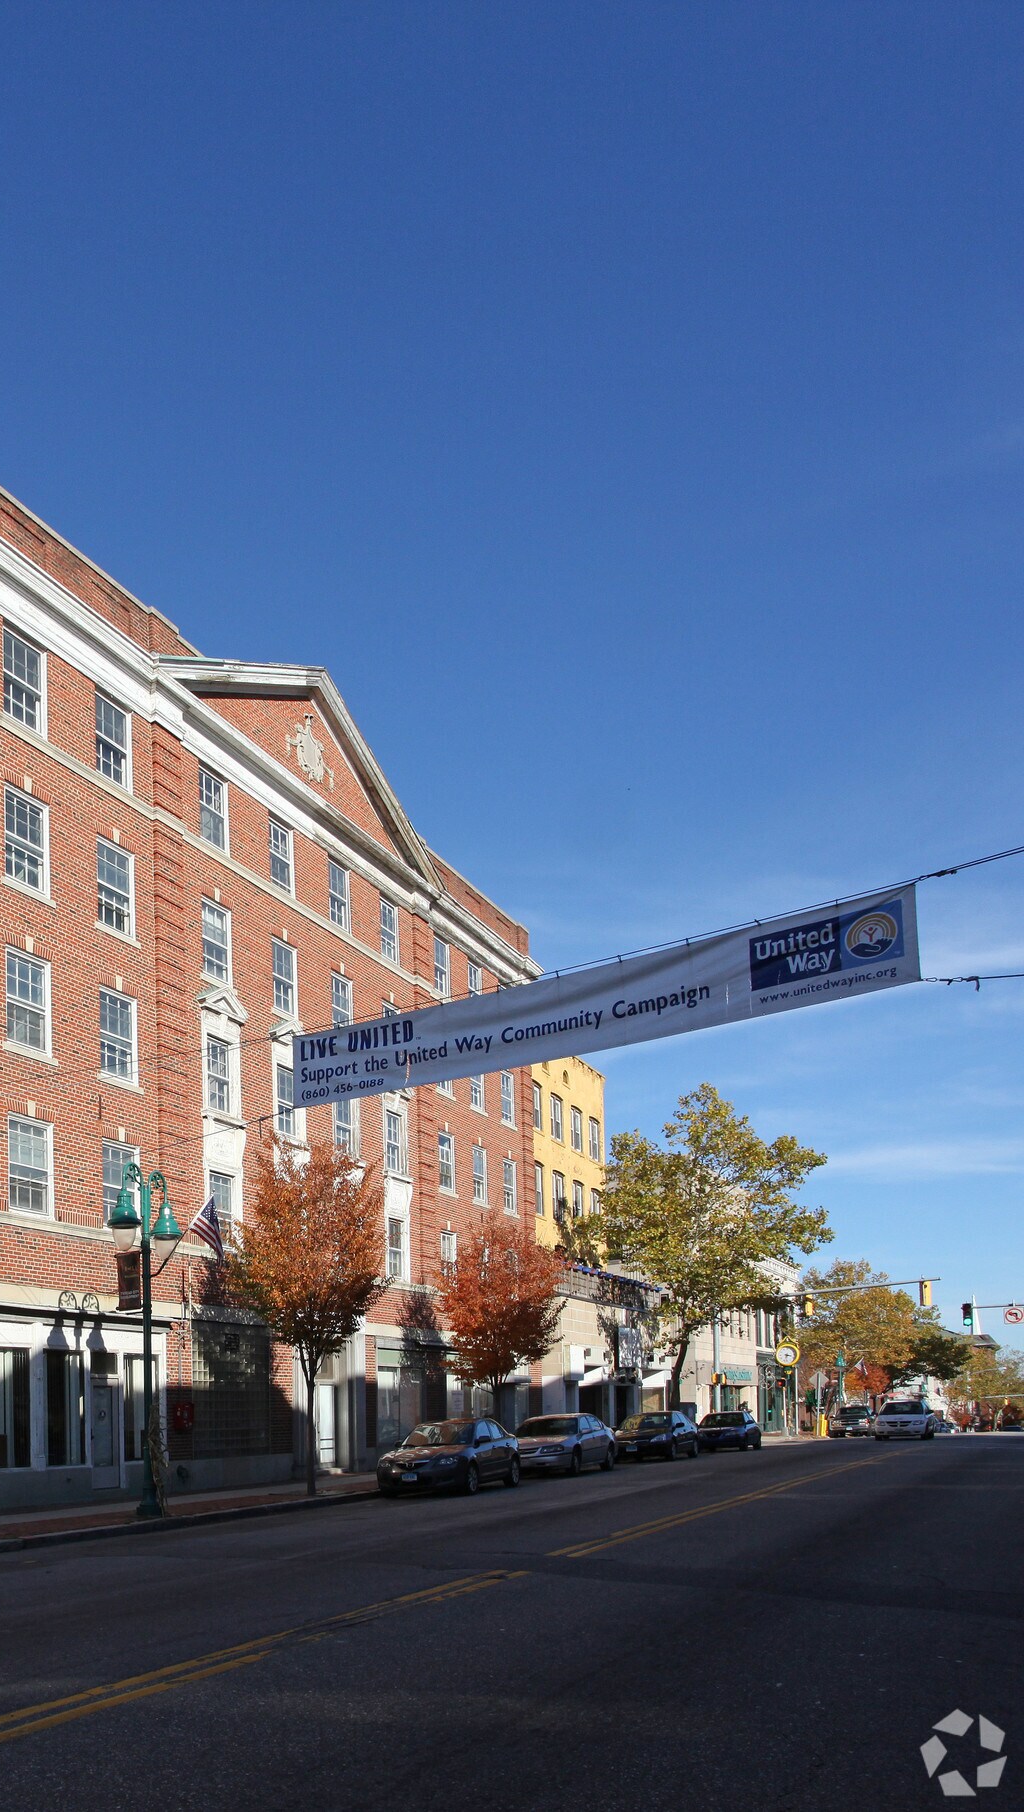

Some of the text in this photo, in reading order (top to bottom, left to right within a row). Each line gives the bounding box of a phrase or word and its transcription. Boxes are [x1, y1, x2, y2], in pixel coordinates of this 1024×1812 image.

[754, 923, 835, 960] United
[786, 949, 836, 974] Way
[759, 967, 897, 1004] www.unitedwayinc.org
[300, 1036, 338, 1062] LIVE
[348, 1020, 414, 1052] UNITED
[301, 984, 711, 1085] Support the United Way Community Campaign
[301, 1078, 385, 1101] (860) 456-0188
